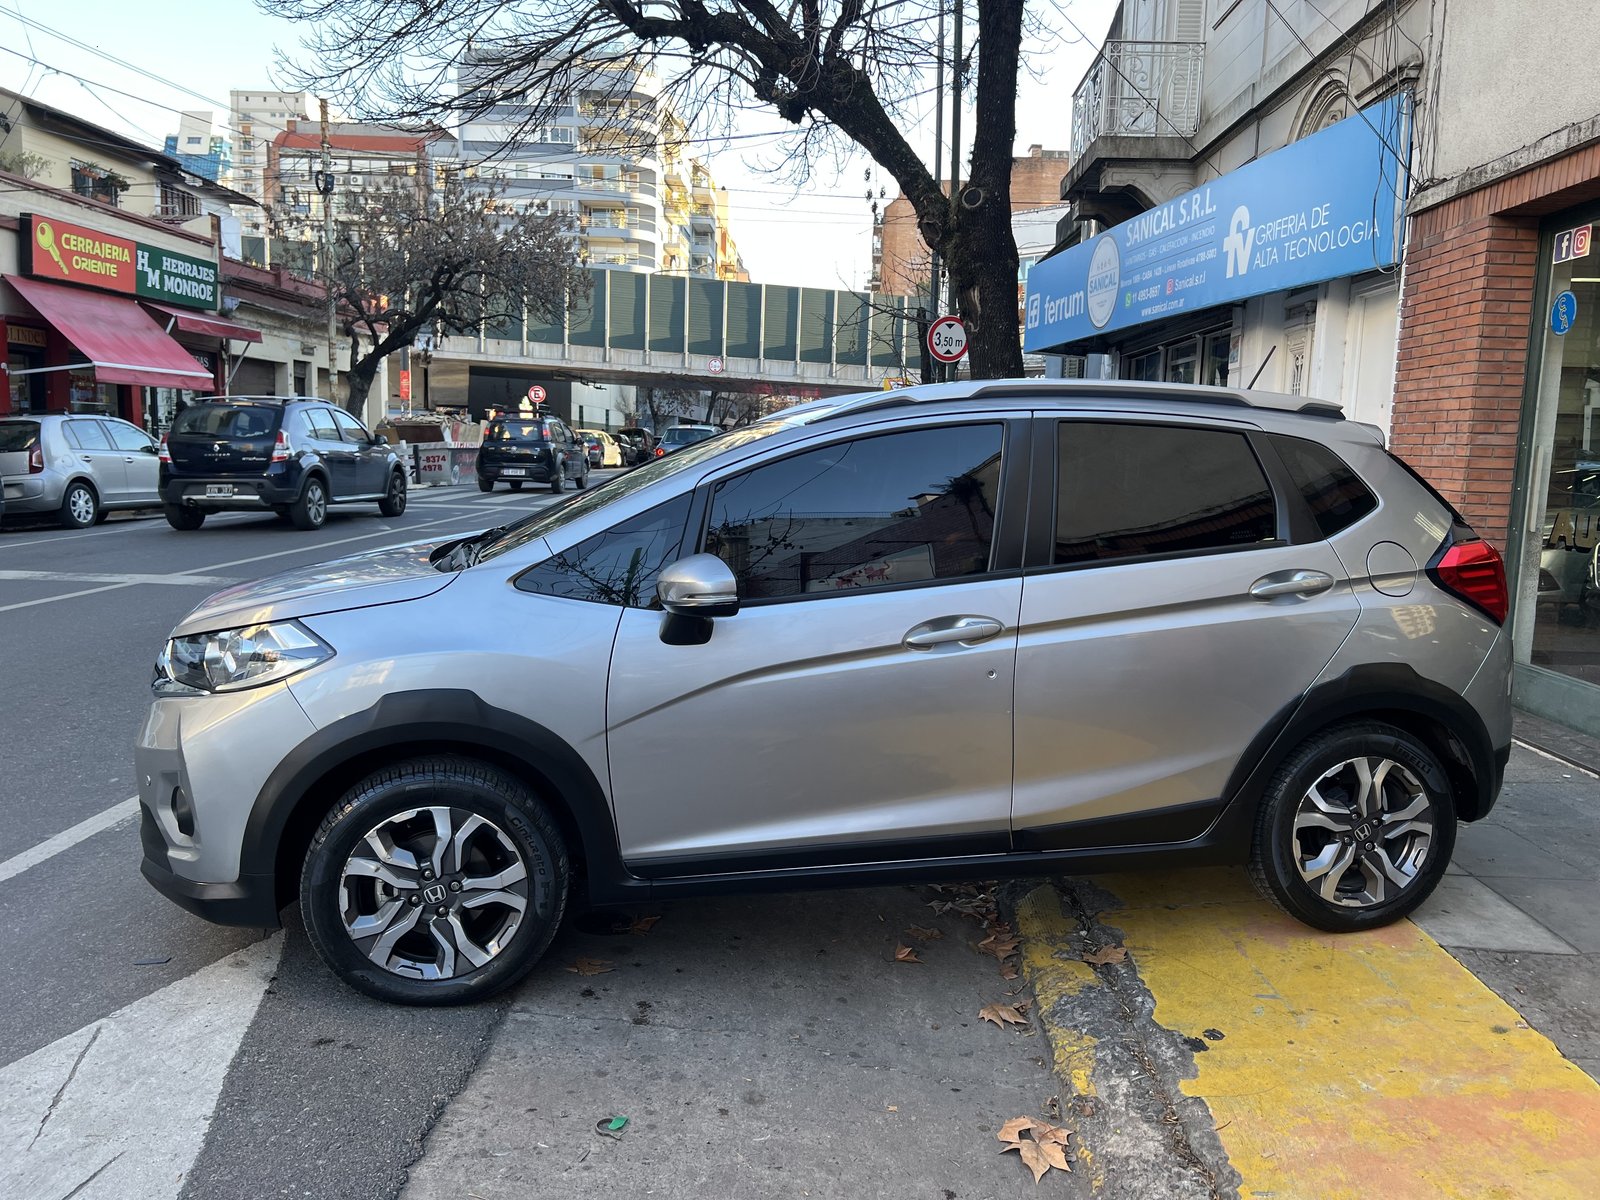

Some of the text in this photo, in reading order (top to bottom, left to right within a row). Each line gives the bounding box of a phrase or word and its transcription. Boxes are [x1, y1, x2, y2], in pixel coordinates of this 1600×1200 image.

[1126, 187, 1217, 247] SANICAL S.R.L.
[1255, 203, 1330, 245] GRIFERIA DE
[61, 233, 131, 263] CERRAJERIA
[1253, 217, 1380, 270] ALTA TECNOLOGIA
[72, 255, 118, 278] ORIENTE
[162, 256, 215, 282] HERRAJES
[163, 274, 213, 301] MONROE
[1089, 271, 1117, 294] SANICAL
[1044, 290, 1084, 325] ferrum
[420, 455, 447, 463] -8374
[1548, 511, 1600, 553] AU
